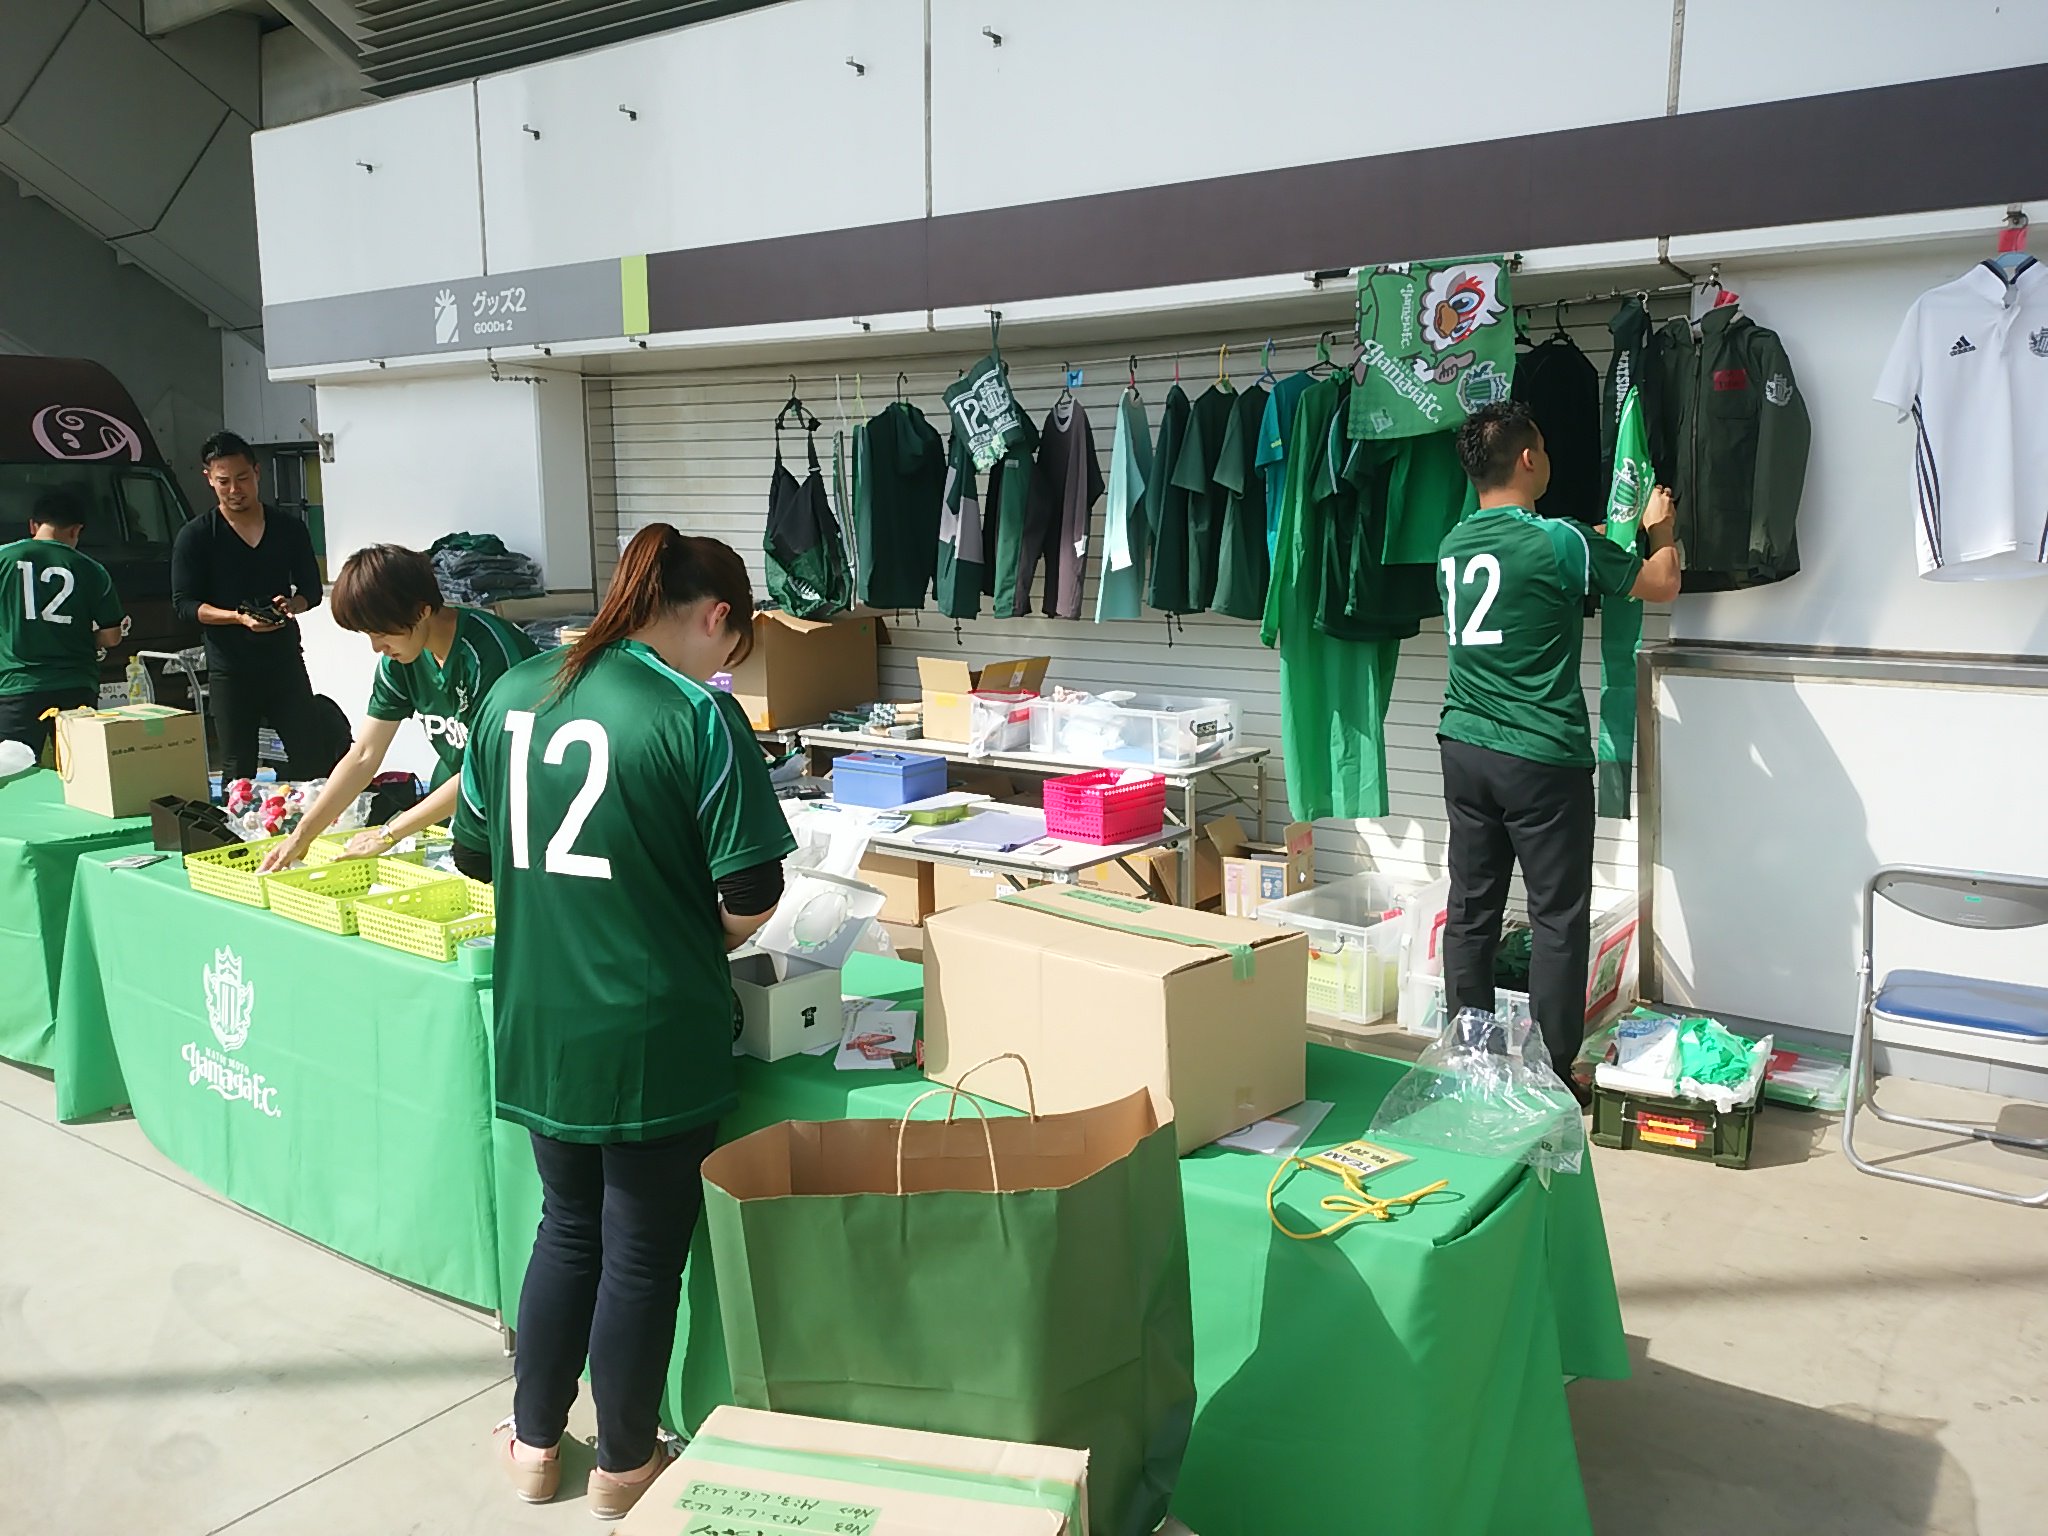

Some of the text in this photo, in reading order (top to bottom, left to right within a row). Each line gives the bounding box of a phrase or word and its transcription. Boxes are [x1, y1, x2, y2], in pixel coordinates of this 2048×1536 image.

[472, 287, 527, 317] グッズ2
[506, 319, 513, 331] 2
[954, 398, 990, 437] 12
[16, 559, 75, 625] 12
[1441, 552, 1503, 646] 12
[504, 709, 612, 880] 12
